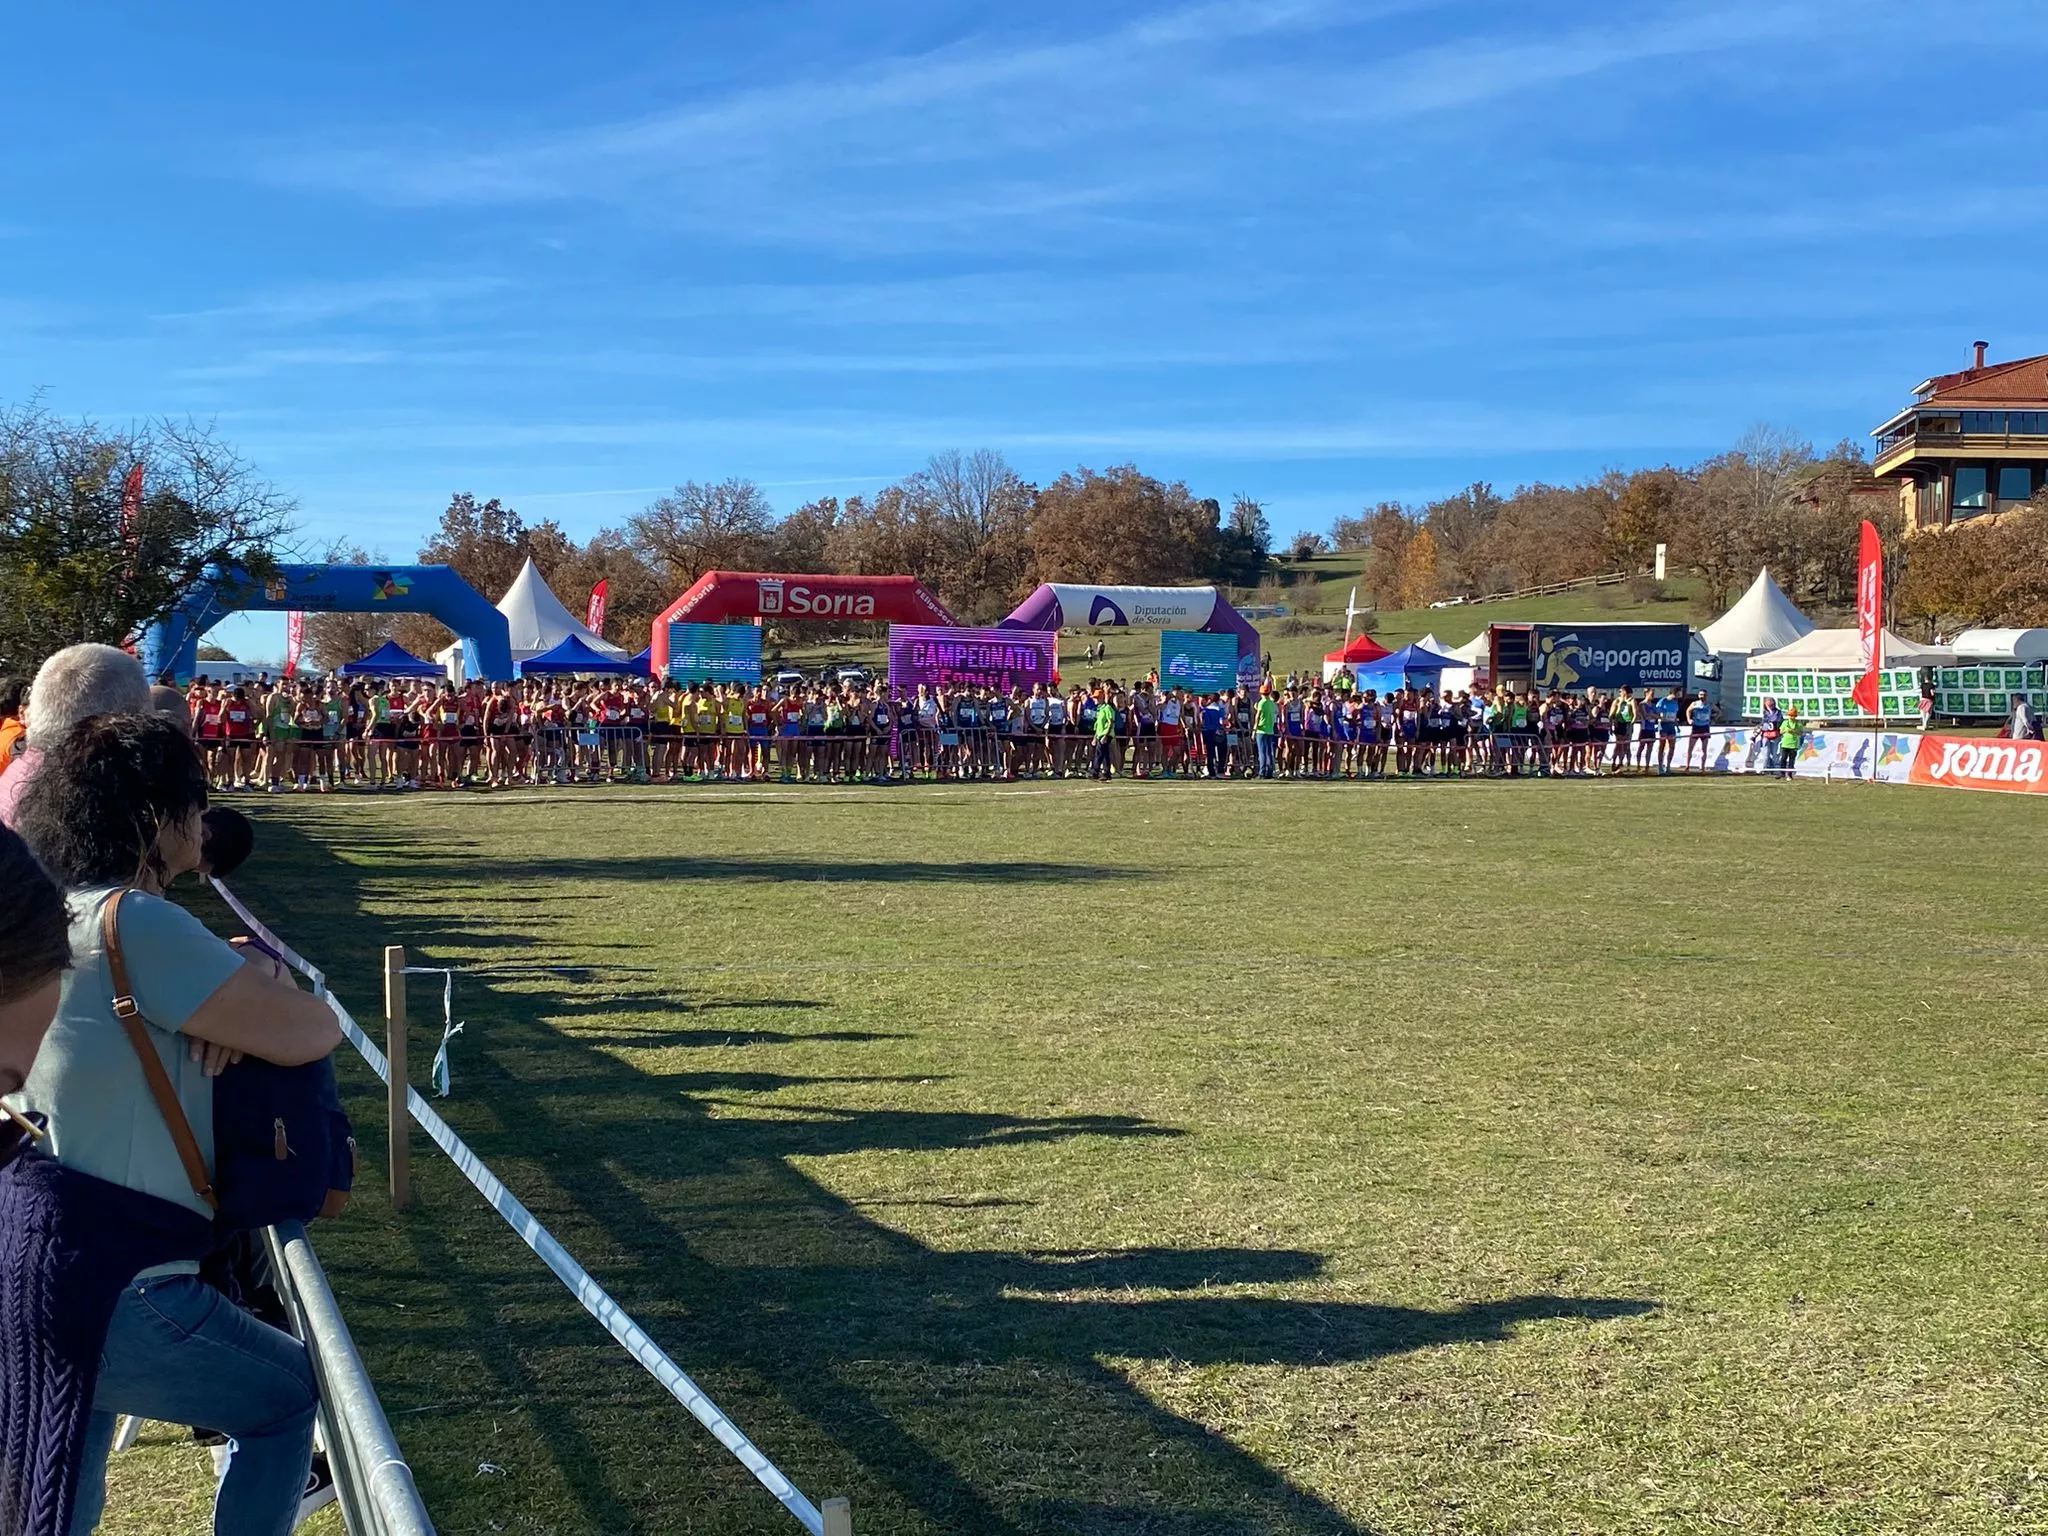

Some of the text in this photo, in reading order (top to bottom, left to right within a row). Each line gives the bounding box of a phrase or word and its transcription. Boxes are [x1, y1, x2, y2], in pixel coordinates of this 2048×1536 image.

[787, 587, 875, 615] Soria
[914, 588, 957, 627] #EligeSori
[1134, 605, 1187, 618] Diputación
[1131, 615, 1171, 625] de Soria
[912, 643, 1038, 671] CAMPEONATO
[1579, 646, 1683, 672] deporama
[1639, 668, 1683, 679] eventos
